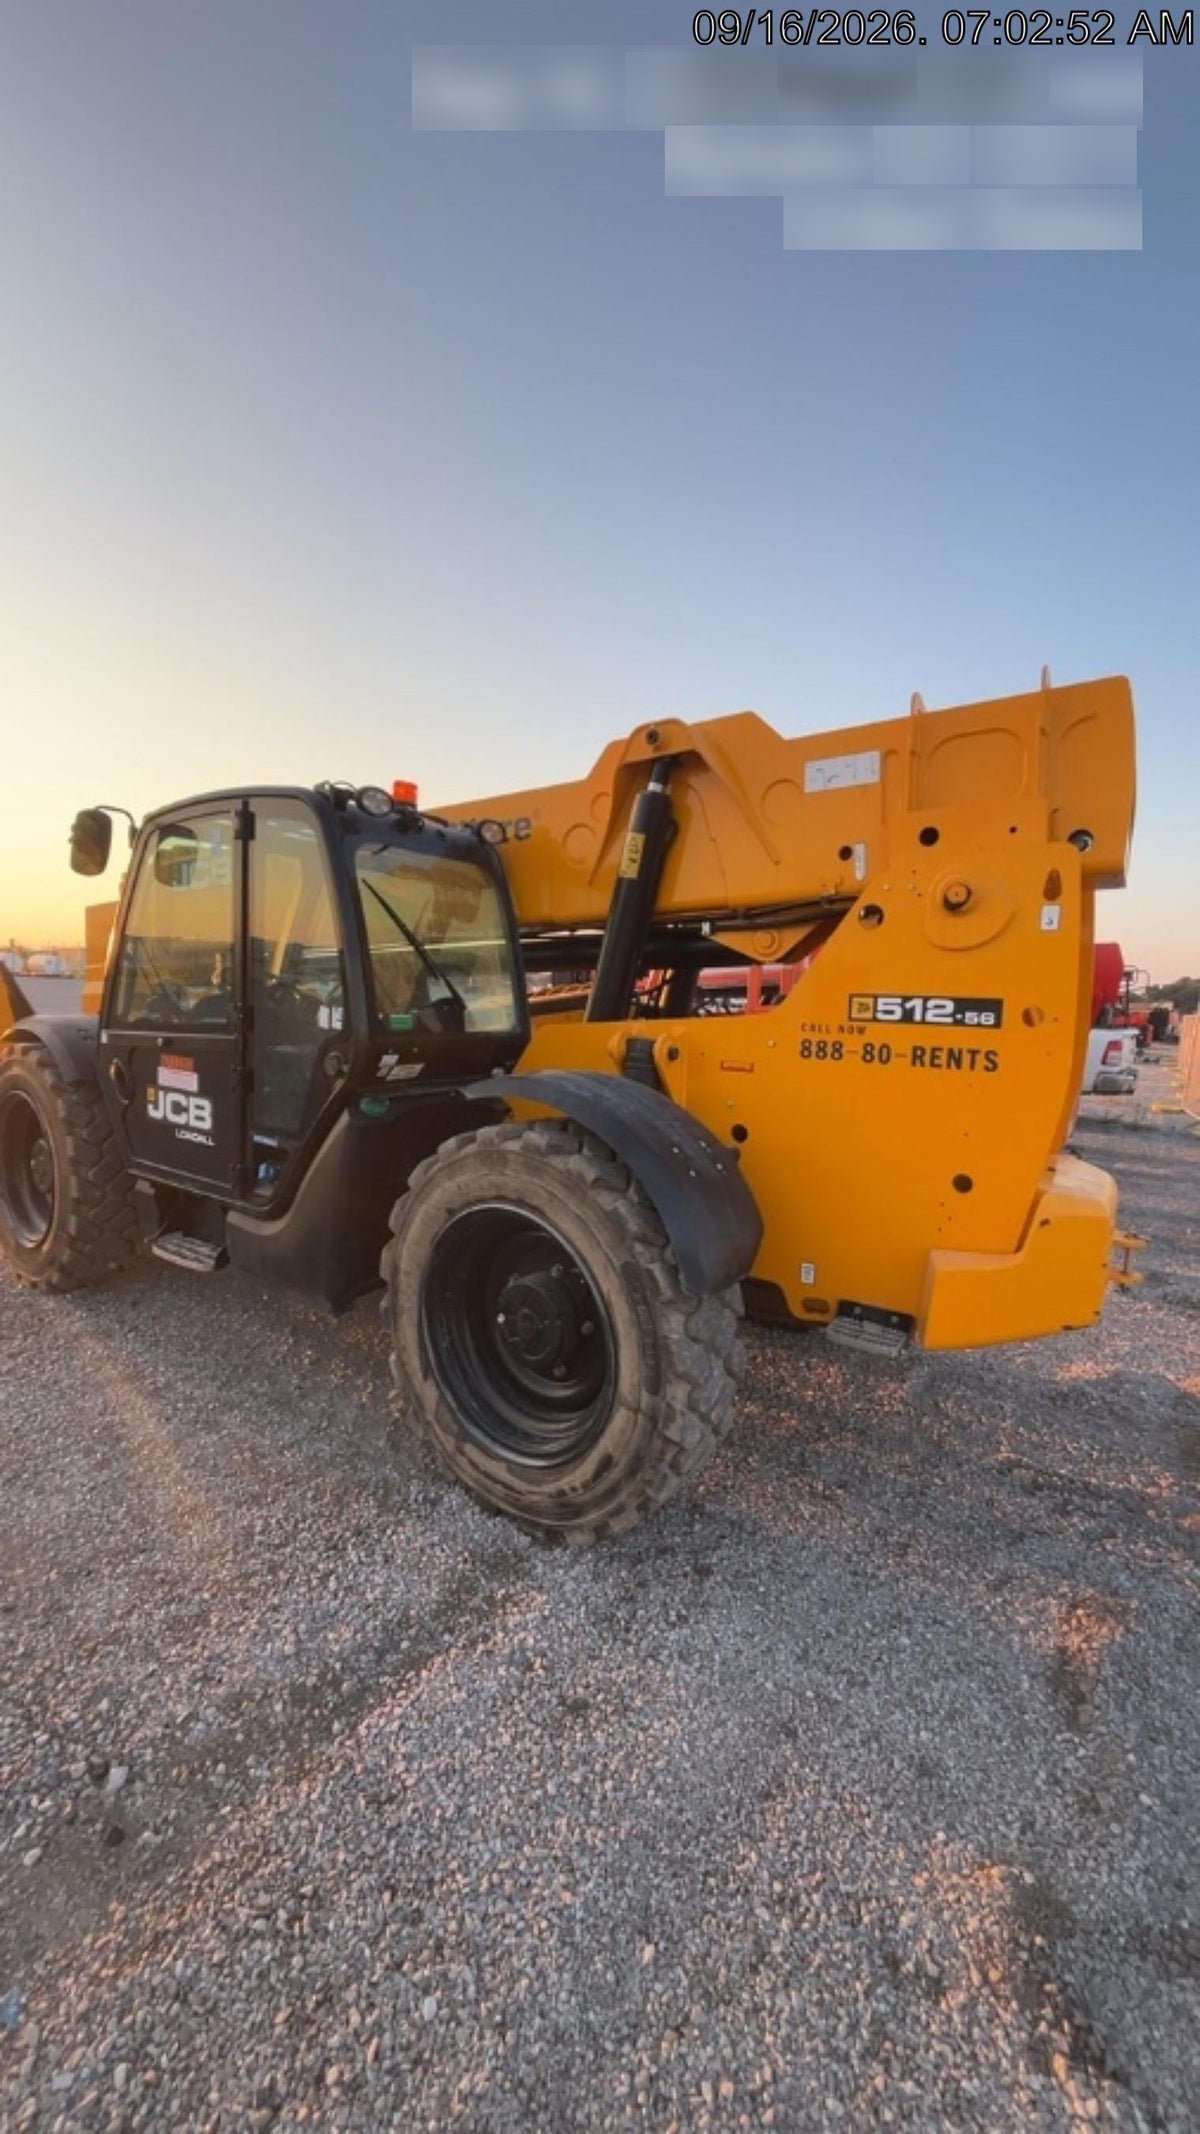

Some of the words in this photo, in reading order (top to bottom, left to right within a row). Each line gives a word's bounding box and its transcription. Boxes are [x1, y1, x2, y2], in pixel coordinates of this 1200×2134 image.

[801, 1022, 831, 1034] CALL
[837, 1024, 867, 1036] NOW
[147, 1088, 212, 1130] JCB
